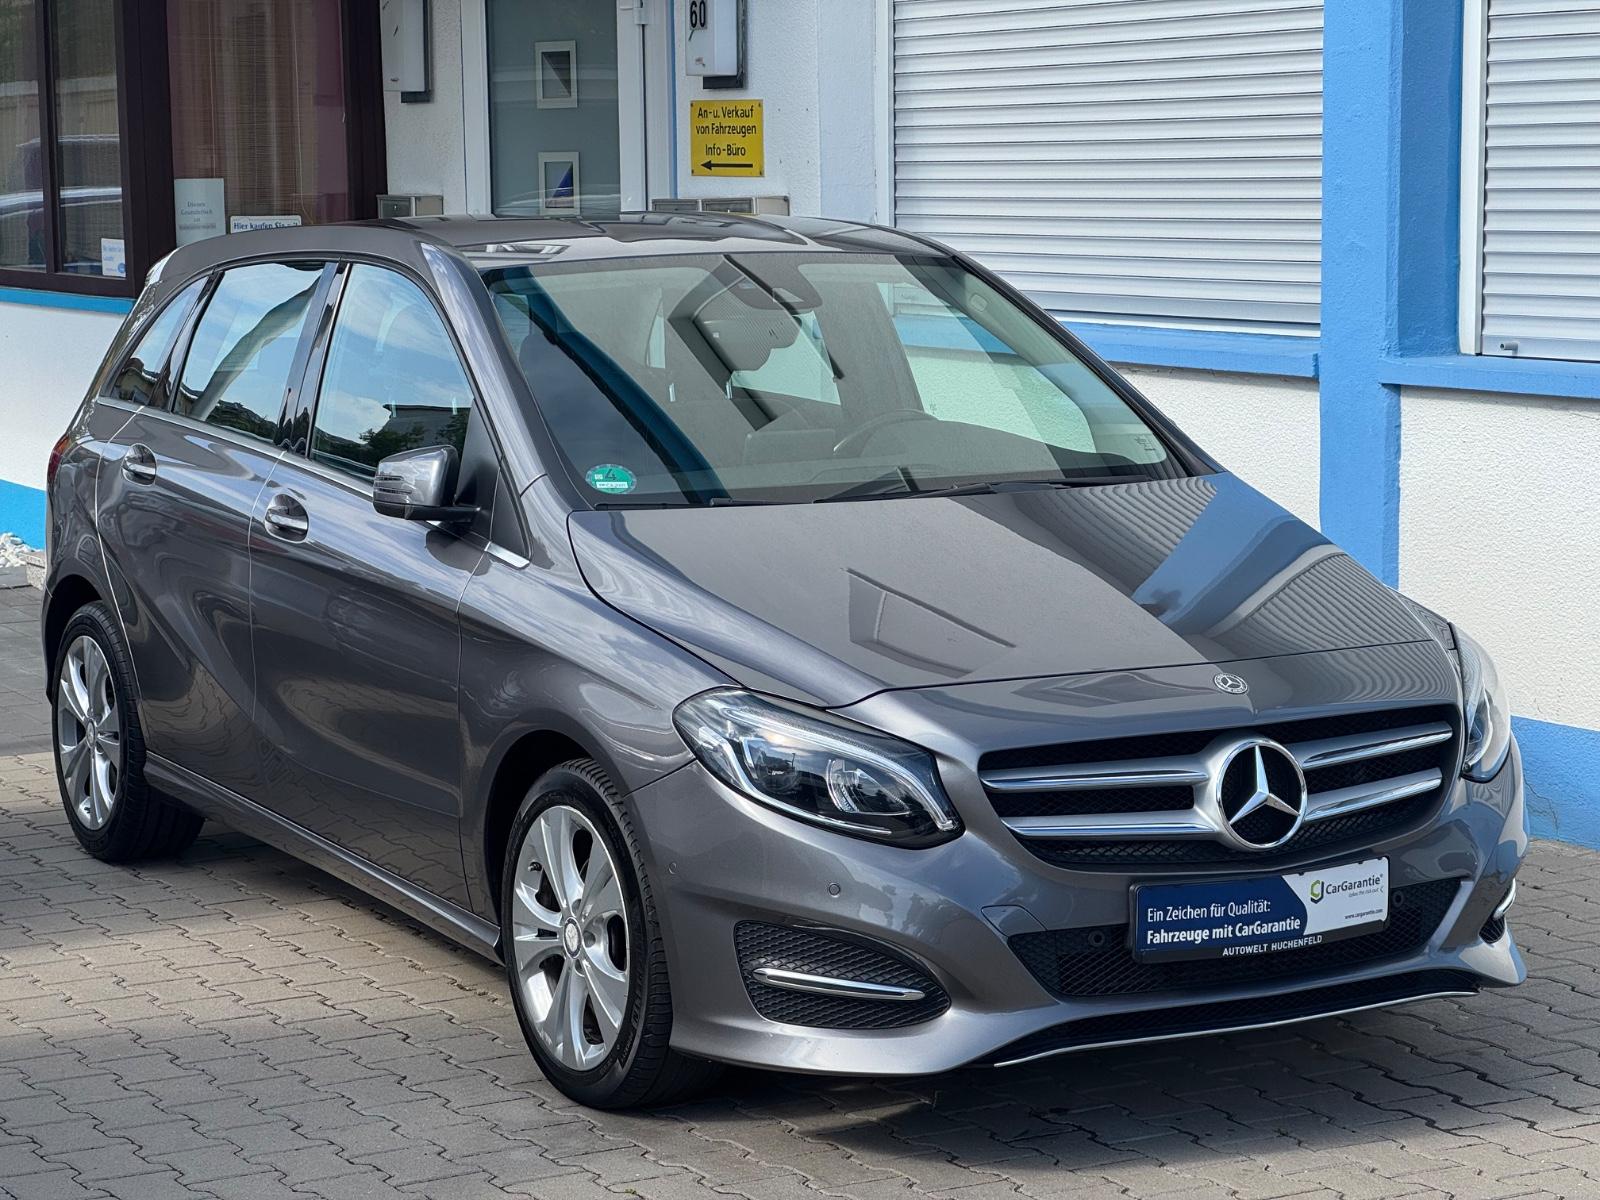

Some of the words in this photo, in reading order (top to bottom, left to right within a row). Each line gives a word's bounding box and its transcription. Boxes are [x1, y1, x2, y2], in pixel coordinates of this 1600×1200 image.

[690, 0, 706, 28] 60
[722, 105, 754, 118] Verkauf
[696, 125, 710, 135] von
[711, 122, 757, 138] Fahrzeugen
[705, 143, 746, 156] Info-Büro
[233, 222, 248, 230] Hier
[605, 468, 617, 481] 4
[1147, 908, 1164, 923] Ein
[1166, 905, 1208, 921] Zeichen
[1210, 903, 1226, 917] für
[1227, 899, 1271, 917] Qualität:
[1147, 929, 1209, 945] Fahrzeuge
[1212, 924, 1233, 939] mit
[1235, 916, 1301, 937] CarGarantie
[1222, 943, 1268, 957] AUTOWELT
[1271, 935, 1323, 951] HUCHENFELD
